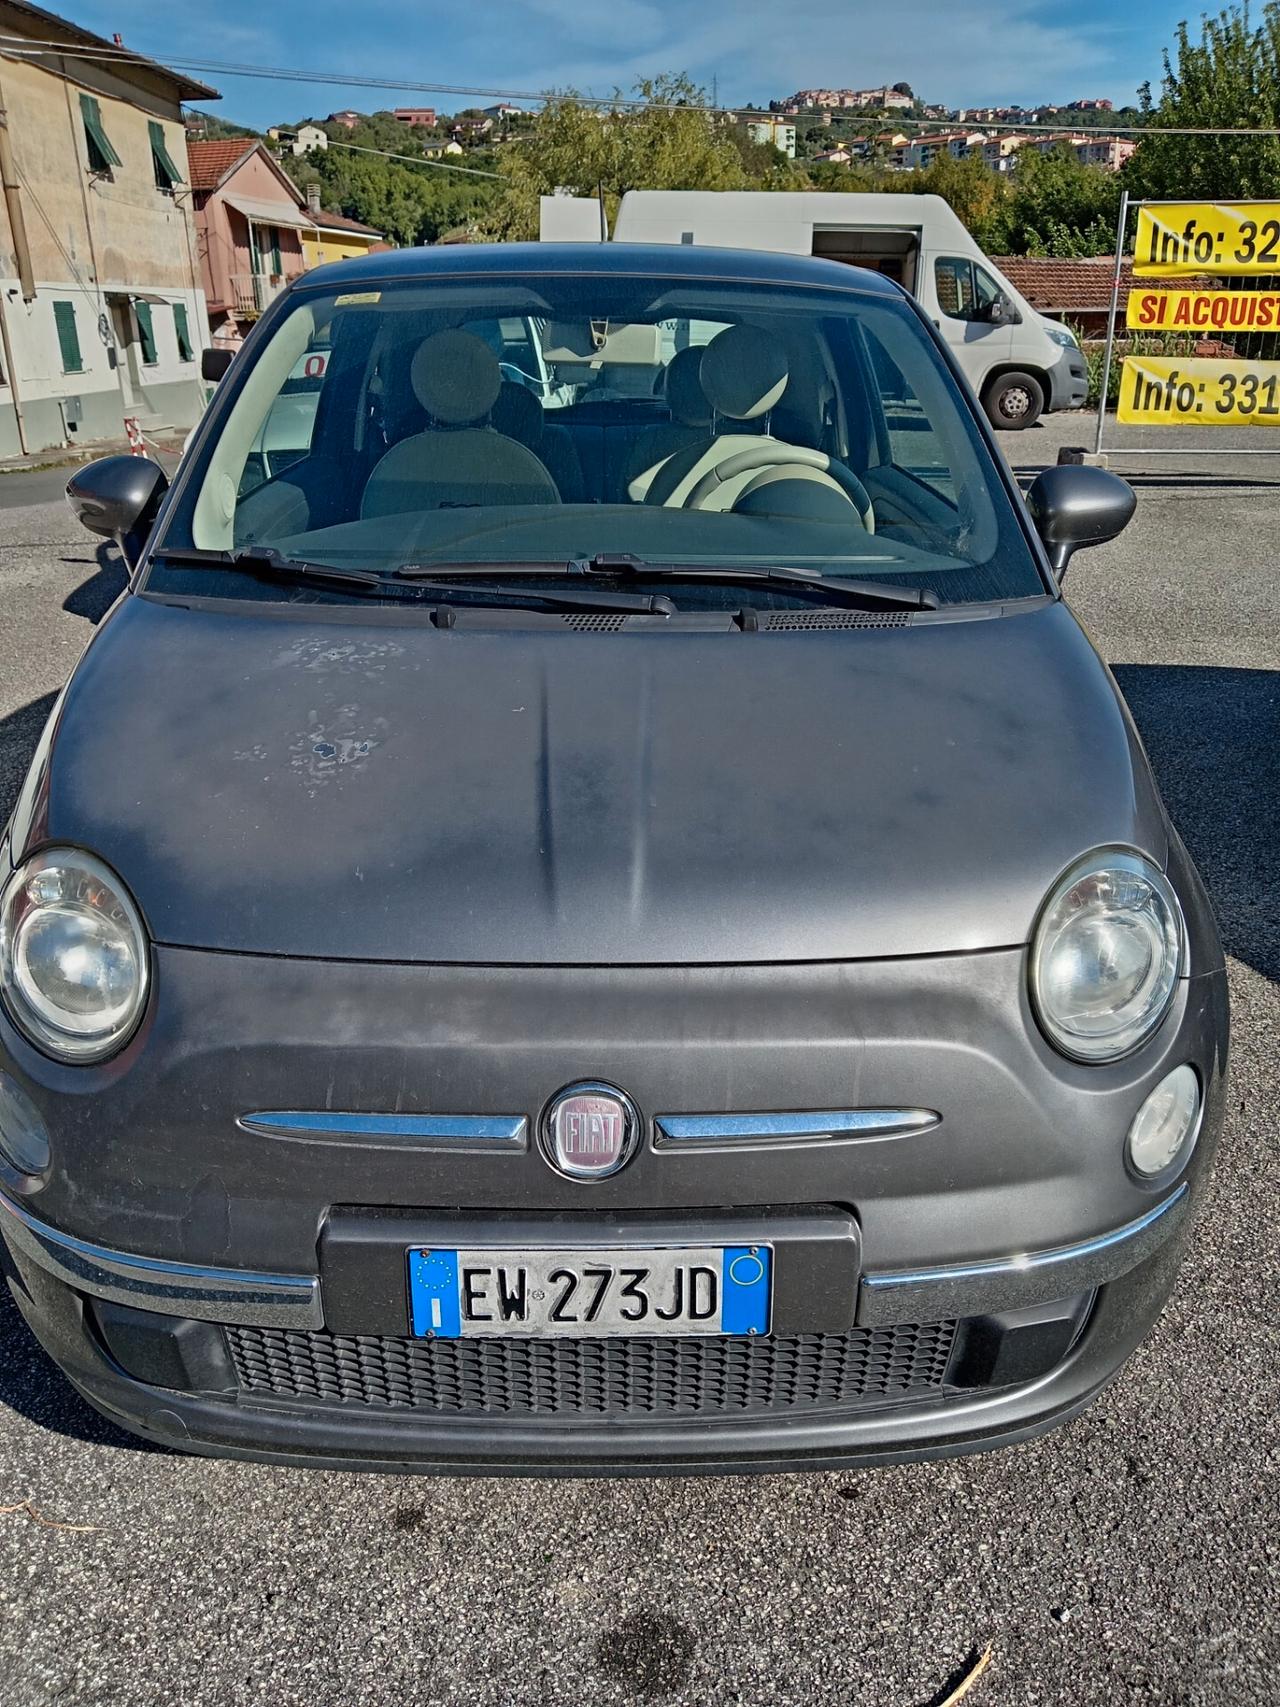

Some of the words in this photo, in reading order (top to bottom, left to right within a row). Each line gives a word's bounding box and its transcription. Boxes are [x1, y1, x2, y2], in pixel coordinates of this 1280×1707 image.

[1150, 219, 1225, 263] Info:
[1139, 295, 1168, 324] SI
[1174, 297, 1280, 328] ACQUIS
[1132, 371, 1205, 412] Info:
[1215, 373, 1279, 414] 331
[565, 1111, 619, 1153] FIAT
[461, 1267, 528, 1321] EW
[548, 1267, 651, 1322] 273
[654, 1266, 718, 1321] JD
